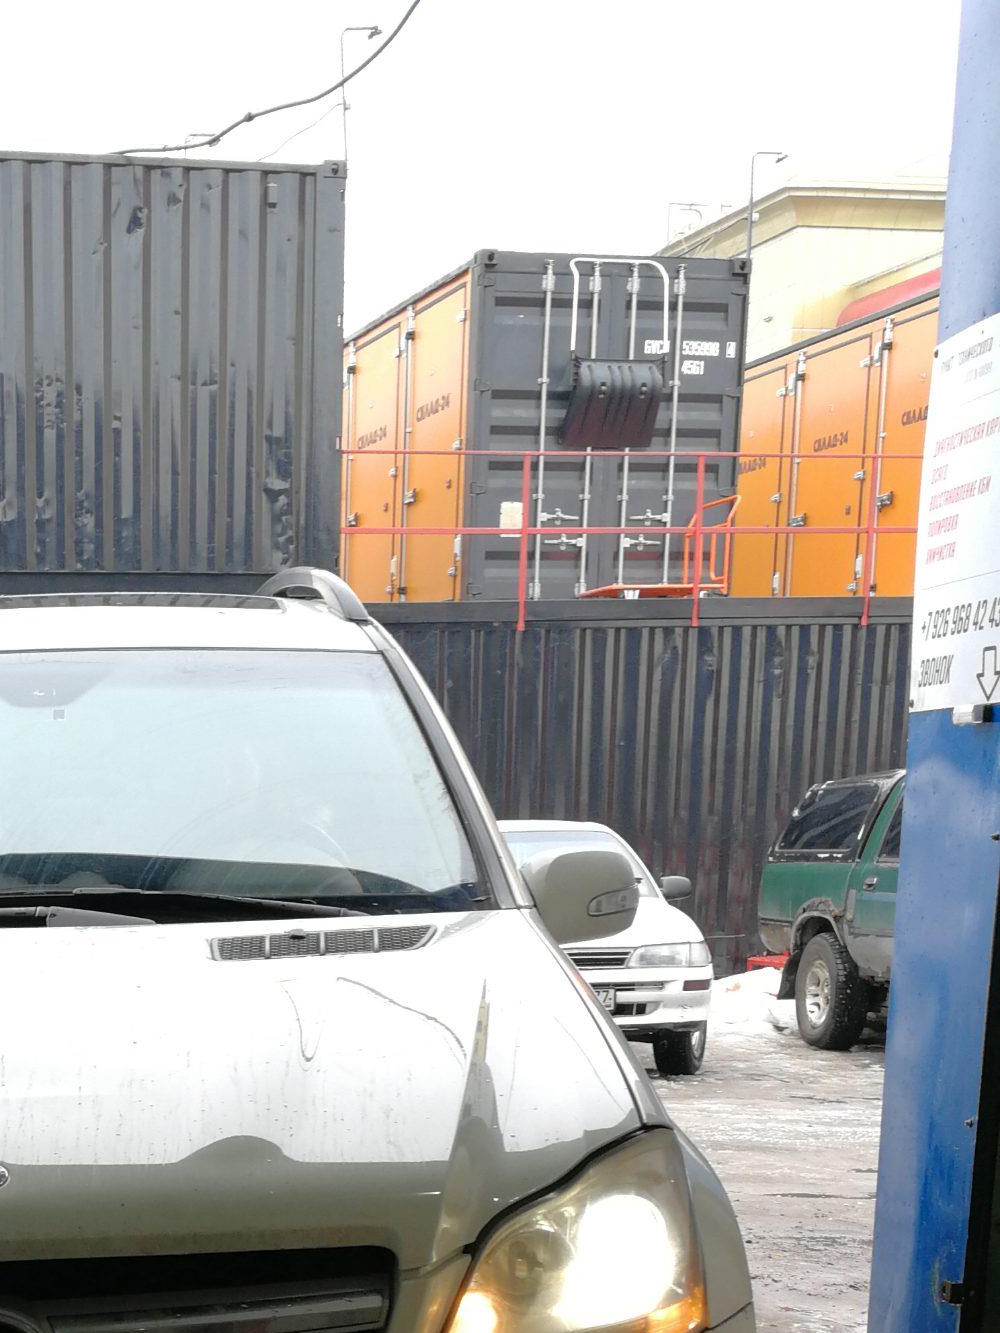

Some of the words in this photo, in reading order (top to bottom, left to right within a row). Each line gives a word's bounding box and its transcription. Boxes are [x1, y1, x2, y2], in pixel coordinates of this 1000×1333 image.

[922, 612, 933, 640] +7
[931, 608, 951, 639] 926
[951, 603, 972, 635] 968
[973, 600, 988, 631] 42
[918, 655, 954, 688] ЗВОНОК
